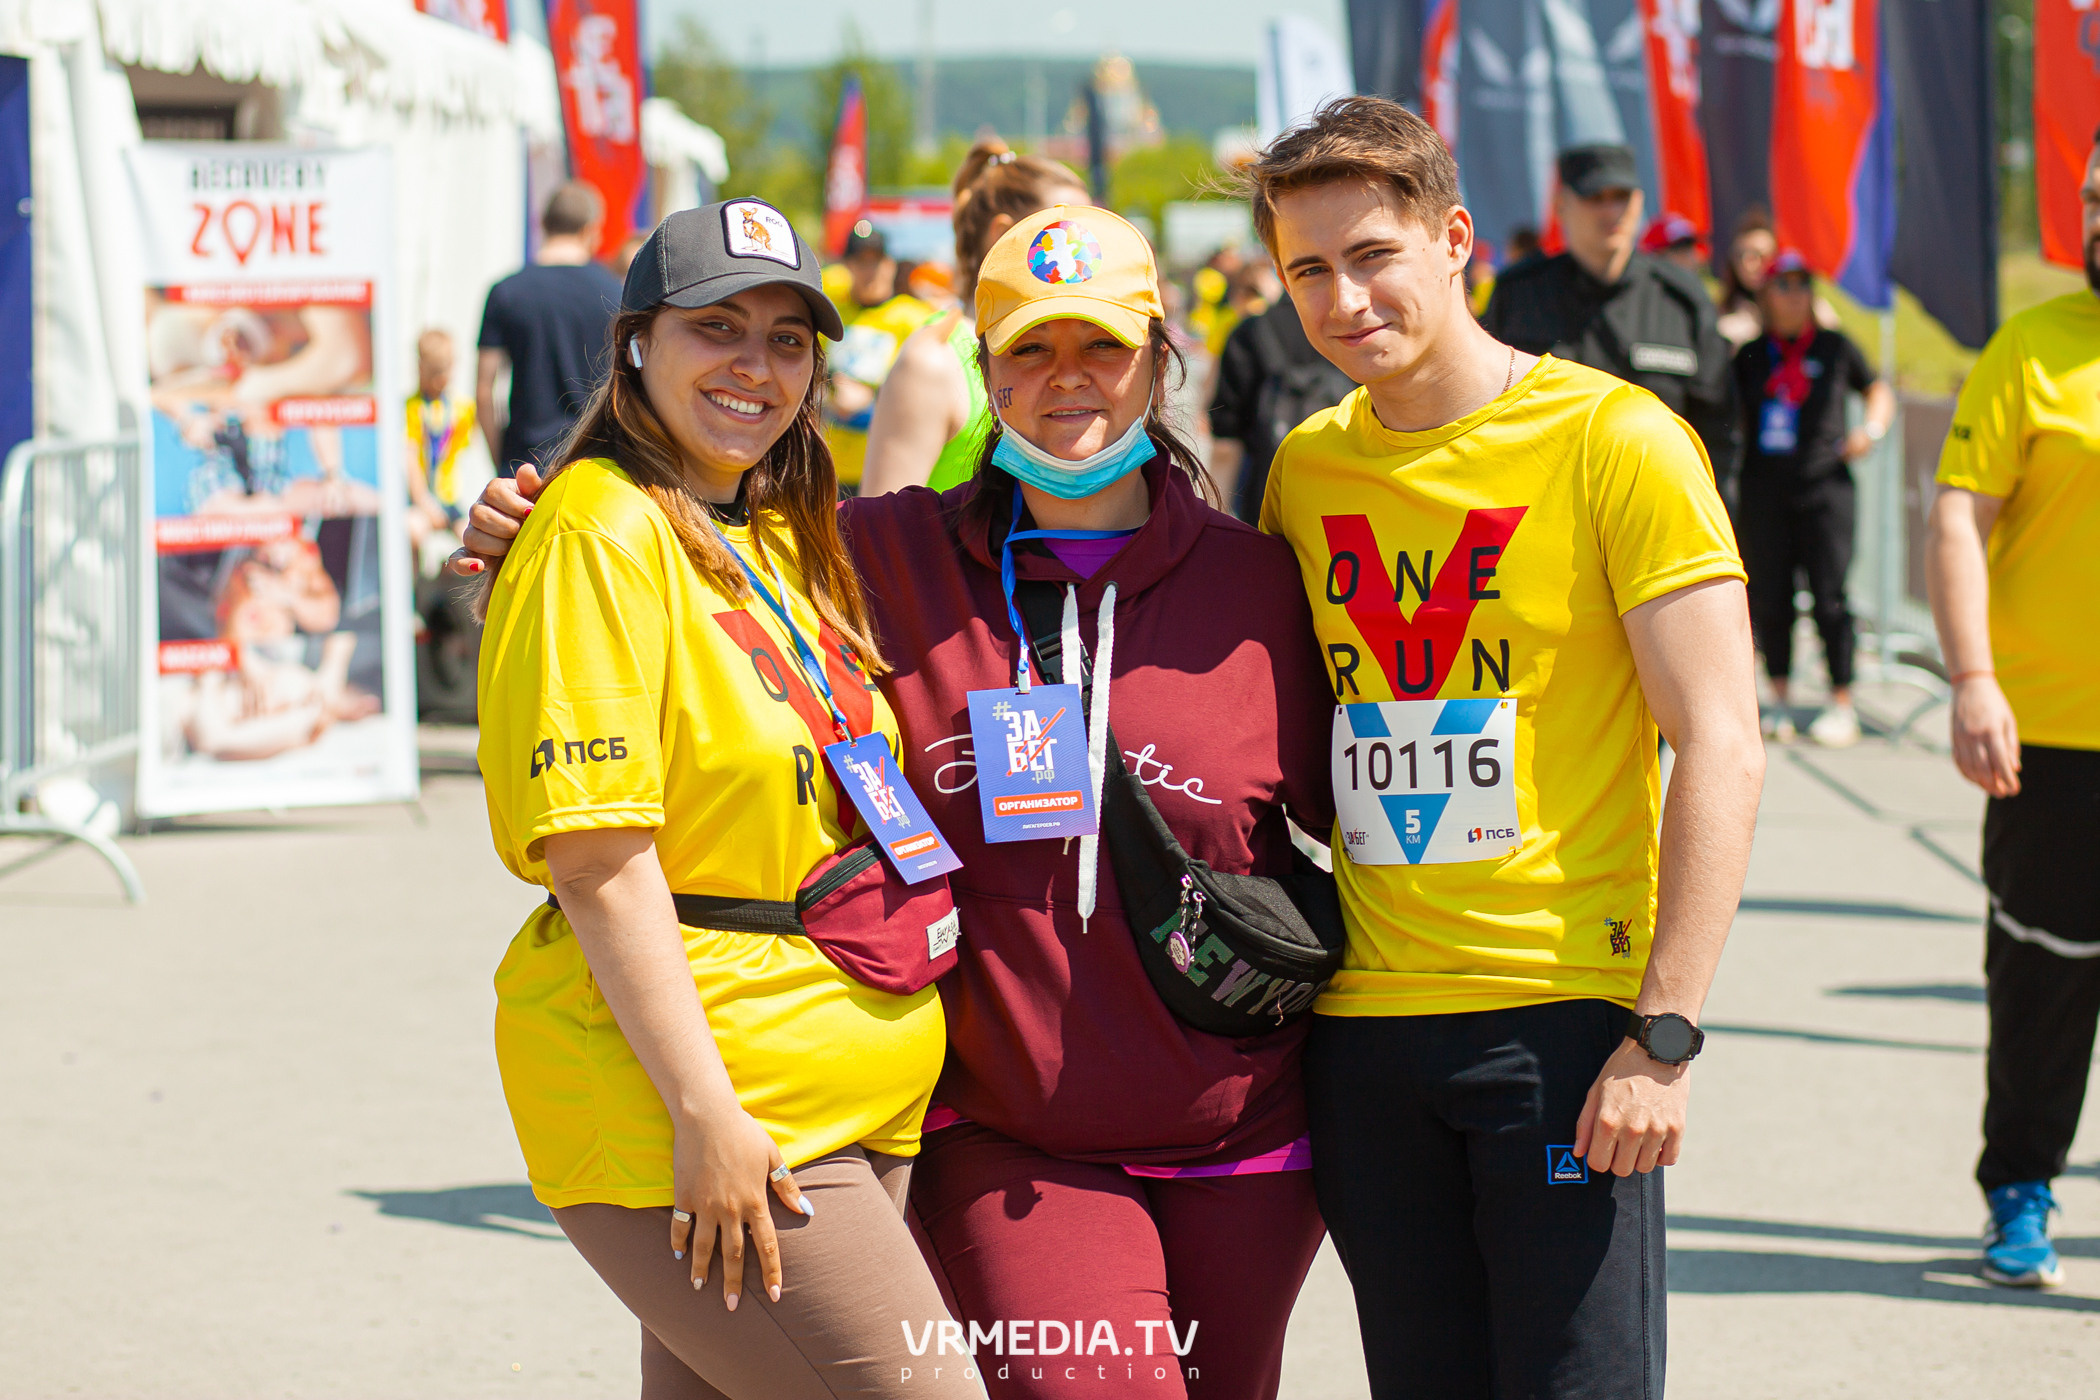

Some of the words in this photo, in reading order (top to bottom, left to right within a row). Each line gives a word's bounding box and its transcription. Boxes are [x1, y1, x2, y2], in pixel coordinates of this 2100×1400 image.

[1326, 546, 1501, 605] ONE
[1328, 639, 1511, 697] RUN
[564, 736, 628, 765] ПСБ
[1007, 738, 1057, 773] БЕГ
[1343, 738, 1502, 791] 10116
[998, 796, 1079, 812] ОРГАНИЗАТОР
[1404, 809, 1422, 834] 5
[1485, 828, 1516, 840] ПСБ
